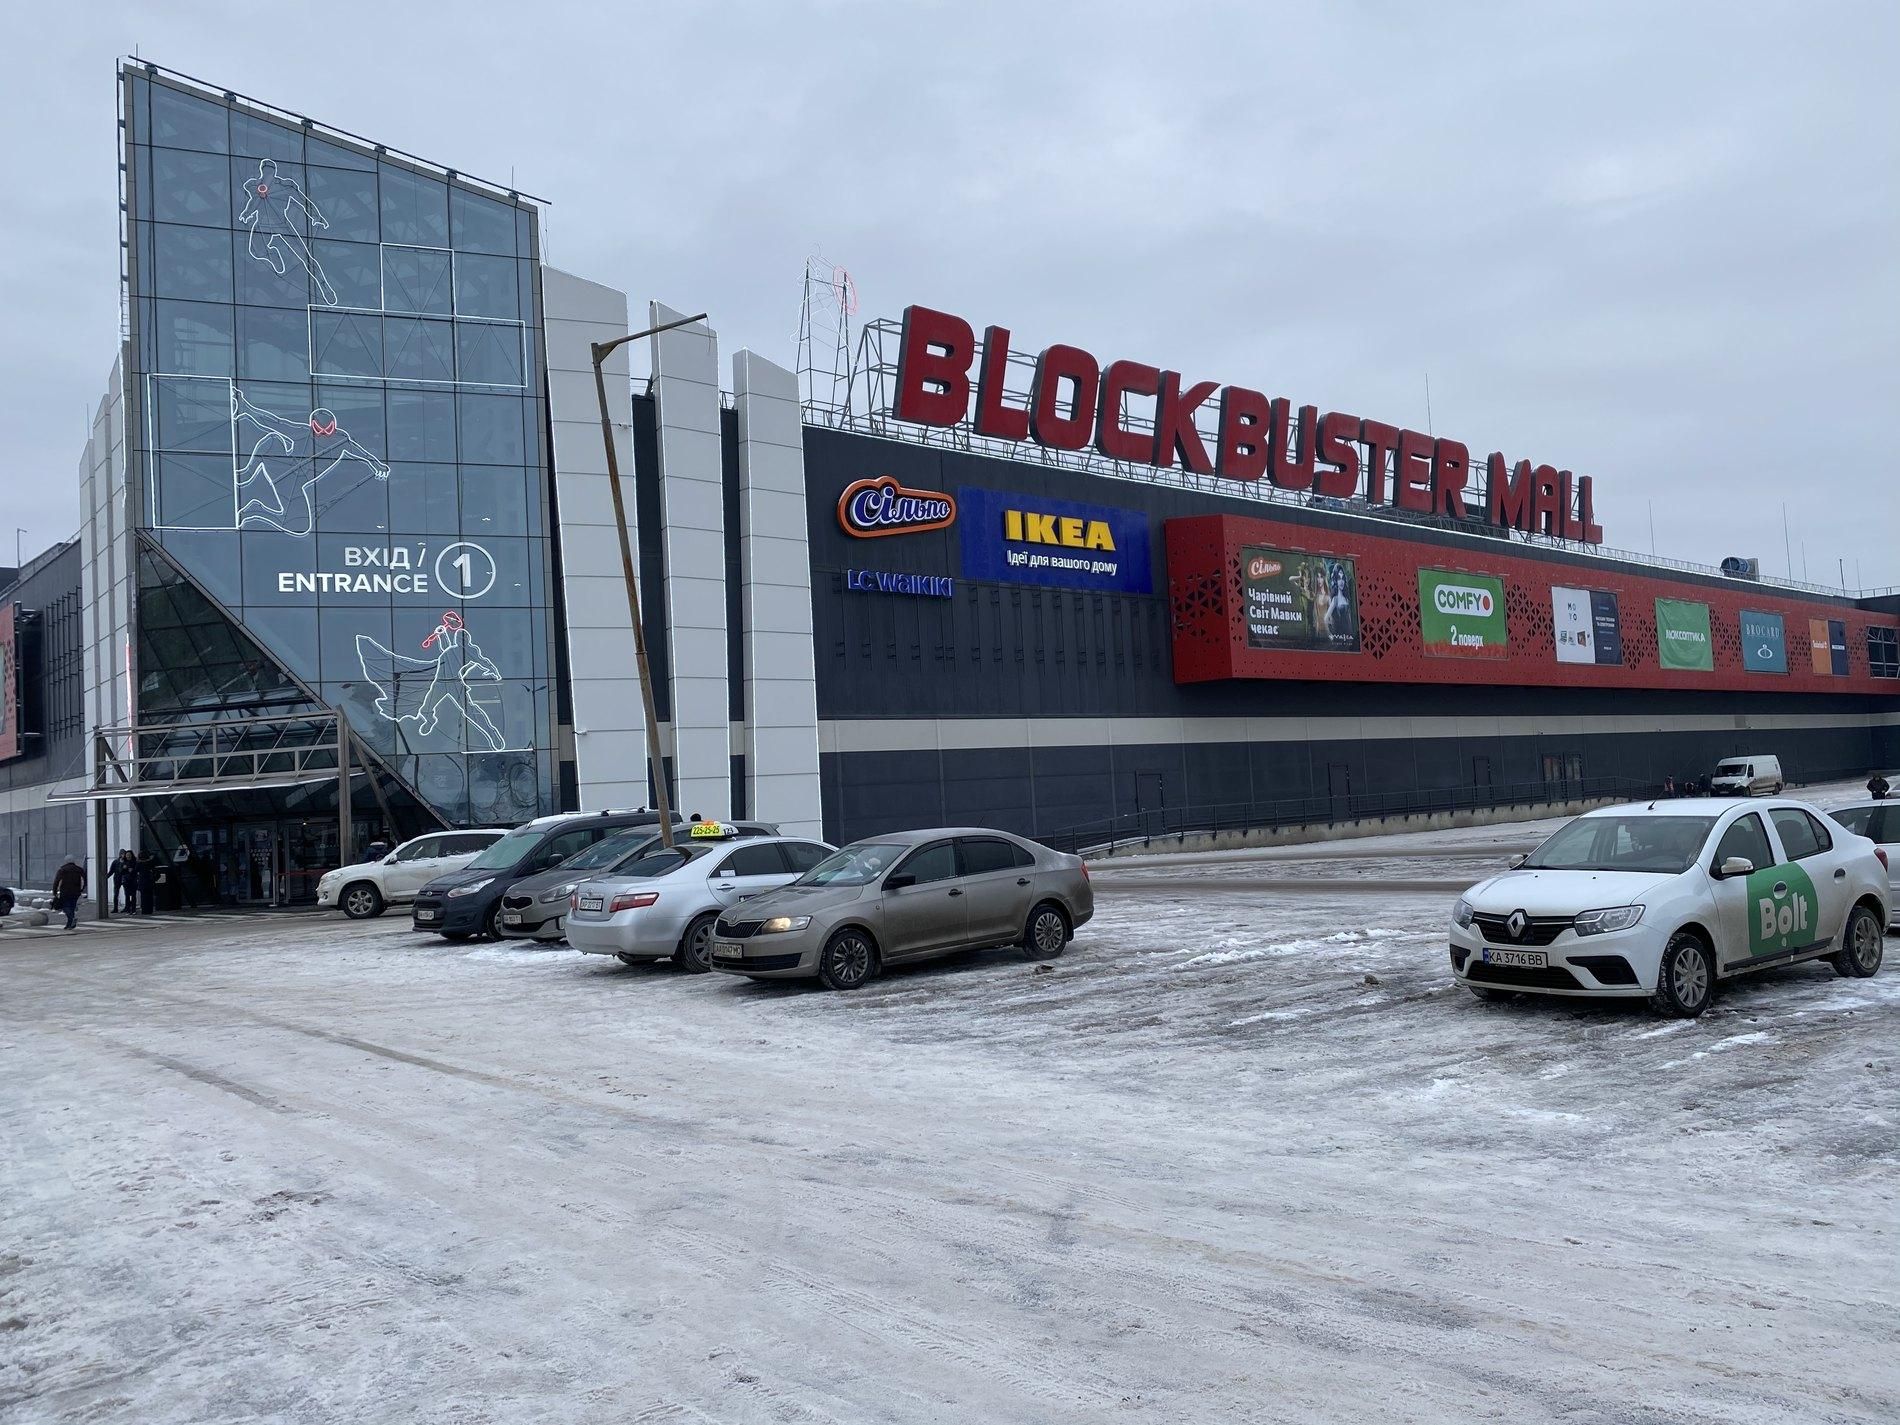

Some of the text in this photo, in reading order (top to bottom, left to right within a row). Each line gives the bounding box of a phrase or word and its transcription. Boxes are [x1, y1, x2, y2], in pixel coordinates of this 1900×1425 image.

[893, 304, 1603, 544] BLOCKBUSTER MALL
[851, 486, 950, 526] Сільпо
[1005, 509, 1116, 551] IKEA
[344, 546, 411, 570] ВХІД
[1006, 550, 1117, 576] Ідеї для вашого дому
[278, 572, 428, 593] ENTRANCE
[452, 553, 472, 588] 1
[847, 569, 872, 591] LC
[1248, 587, 1292, 604] Чарівний
[1437, 589, 1482, 611] COMFY
[1249, 605, 1302, 622] Світ Мавки
[1250, 623, 1279, 635] чекає
[1450, 624, 1484, 650] 2 поверх
[1759, 891, 1808, 941] Bolt
[1489, 951, 1543, 966] KA 3716 BB
